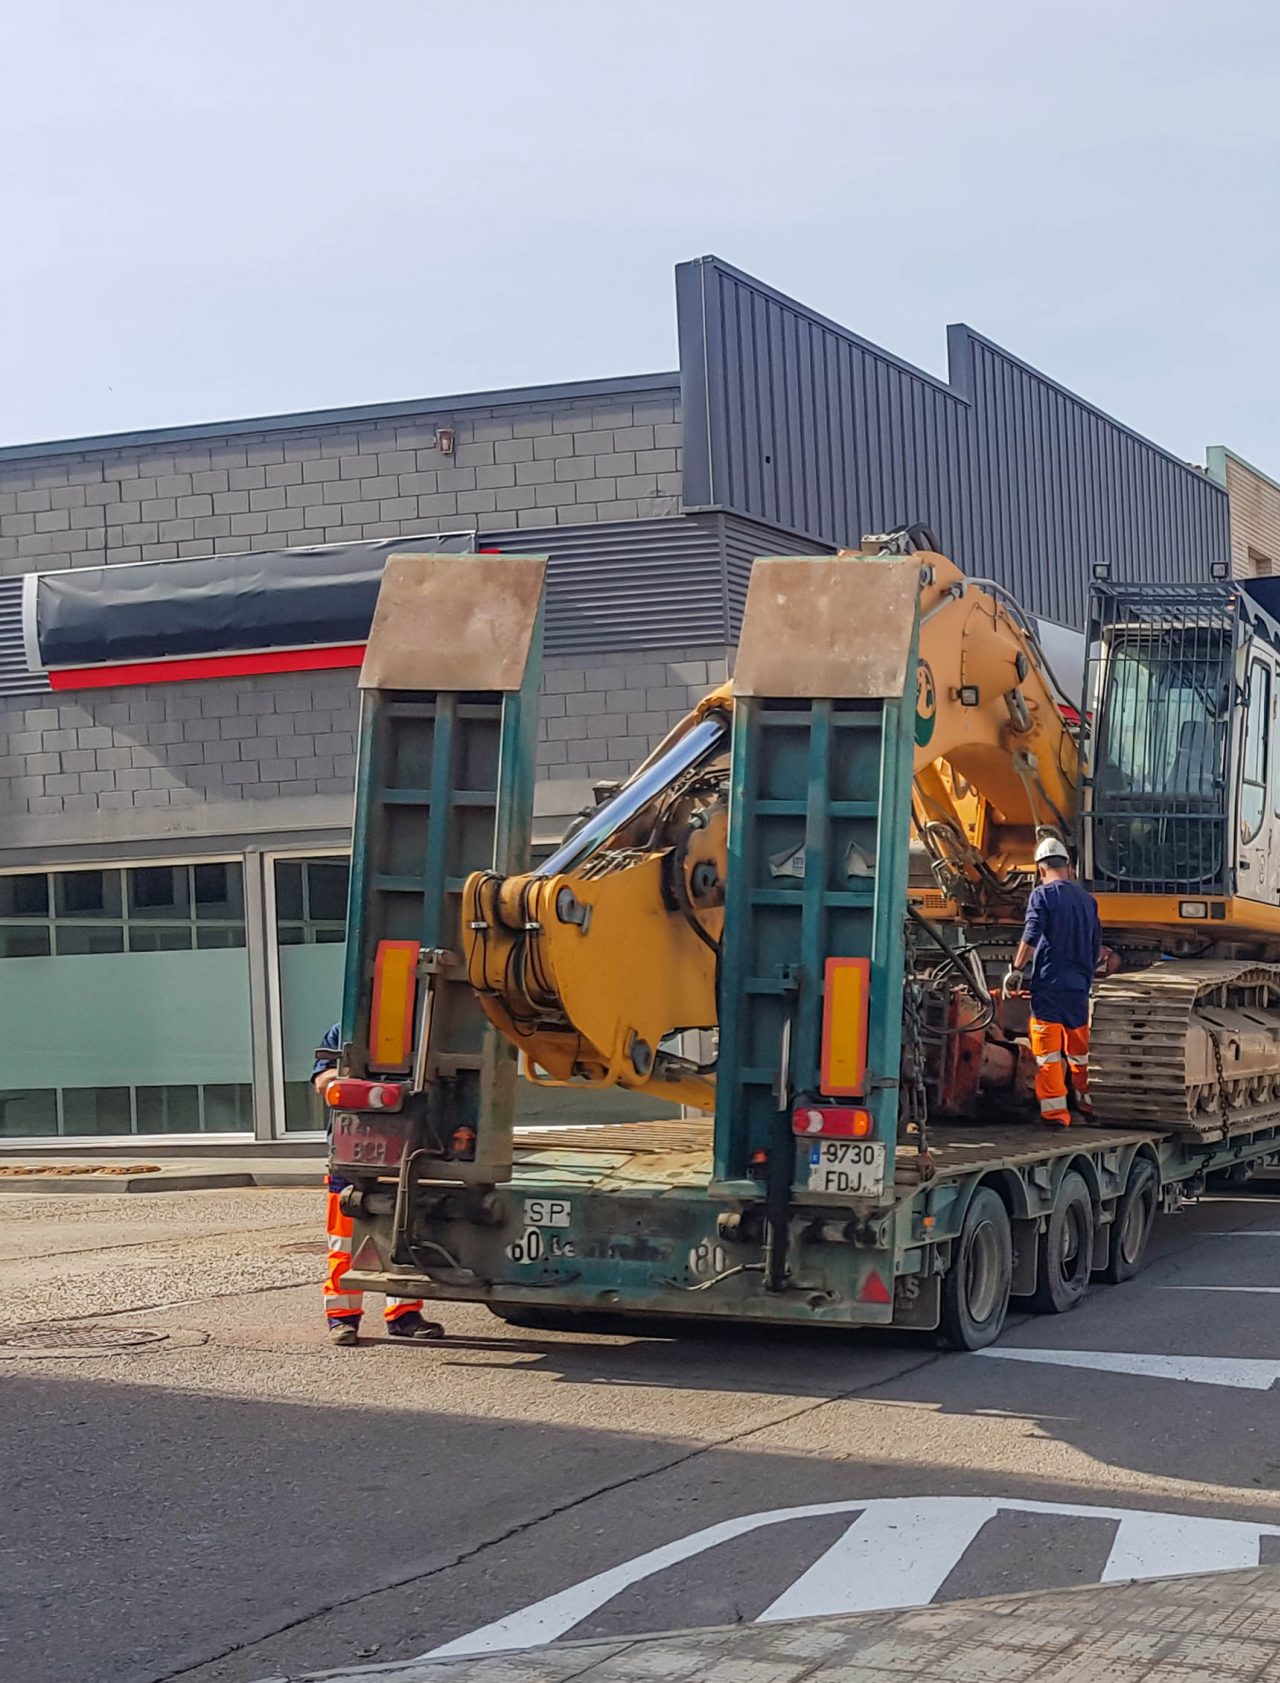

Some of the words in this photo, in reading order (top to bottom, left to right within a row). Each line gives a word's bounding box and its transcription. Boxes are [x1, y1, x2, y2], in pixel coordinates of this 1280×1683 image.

[826, 1143, 875, 1165] 9730
[825, 1170, 862, 1192] FDJ
[529, 1202, 565, 1224] SP
